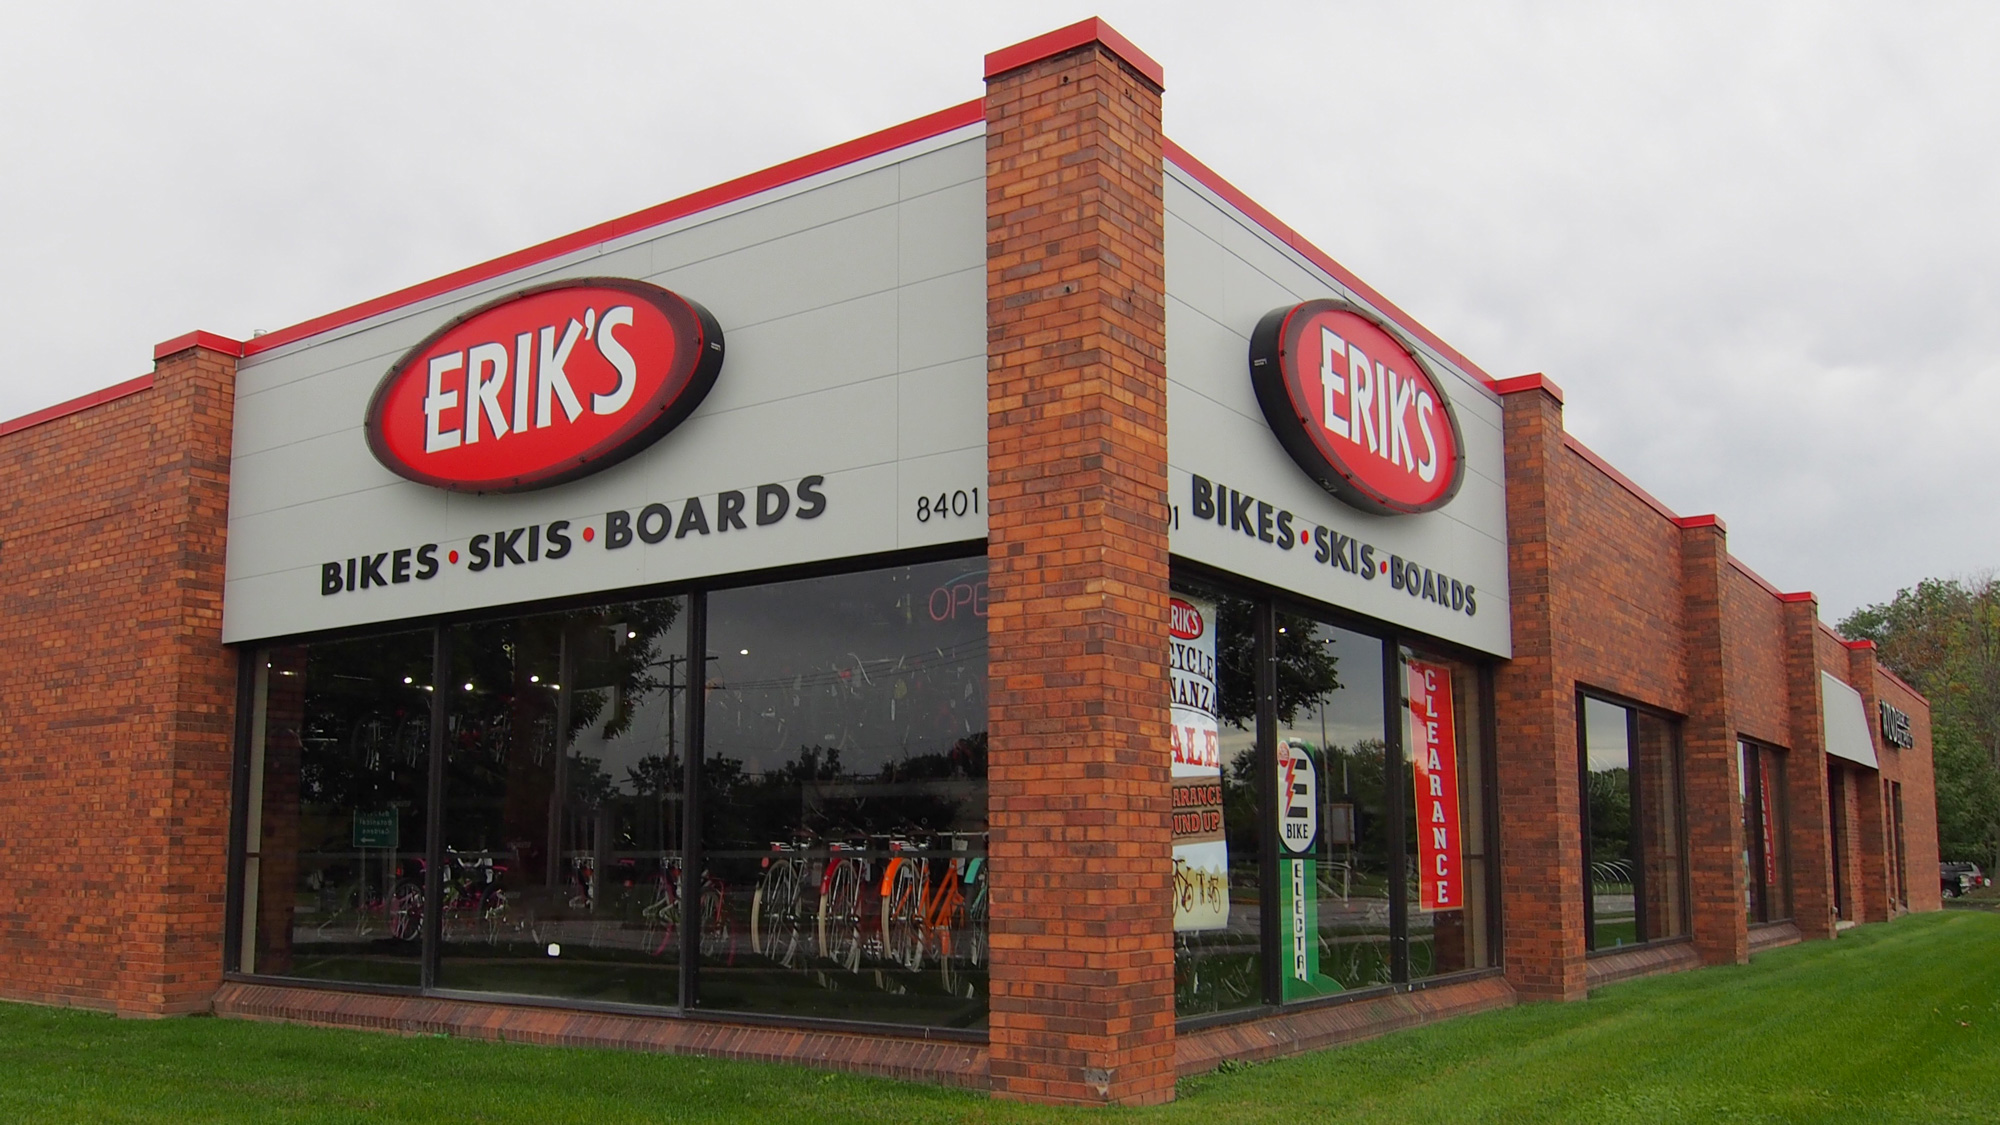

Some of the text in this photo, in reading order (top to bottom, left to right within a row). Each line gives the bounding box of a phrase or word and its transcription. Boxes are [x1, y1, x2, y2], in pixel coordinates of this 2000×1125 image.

[423, 305, 637, 454] ERIK'S
[1320, 324, 1437, 483] ERIK'S
[321, 474, 827, 595] BIKES SKIS BOARDS
[916, 487, 978, 522] 8401
[1192, 474, 1477, 616] BIKES SKIS BOARDS
[1169, 604, 1199, 636] RIK'S
[1172, 812, 1220, 834] UND UP
[1286, 823, 1309, 839] BIKE
[1424, 669, 1448, 903] CLEARANCE
